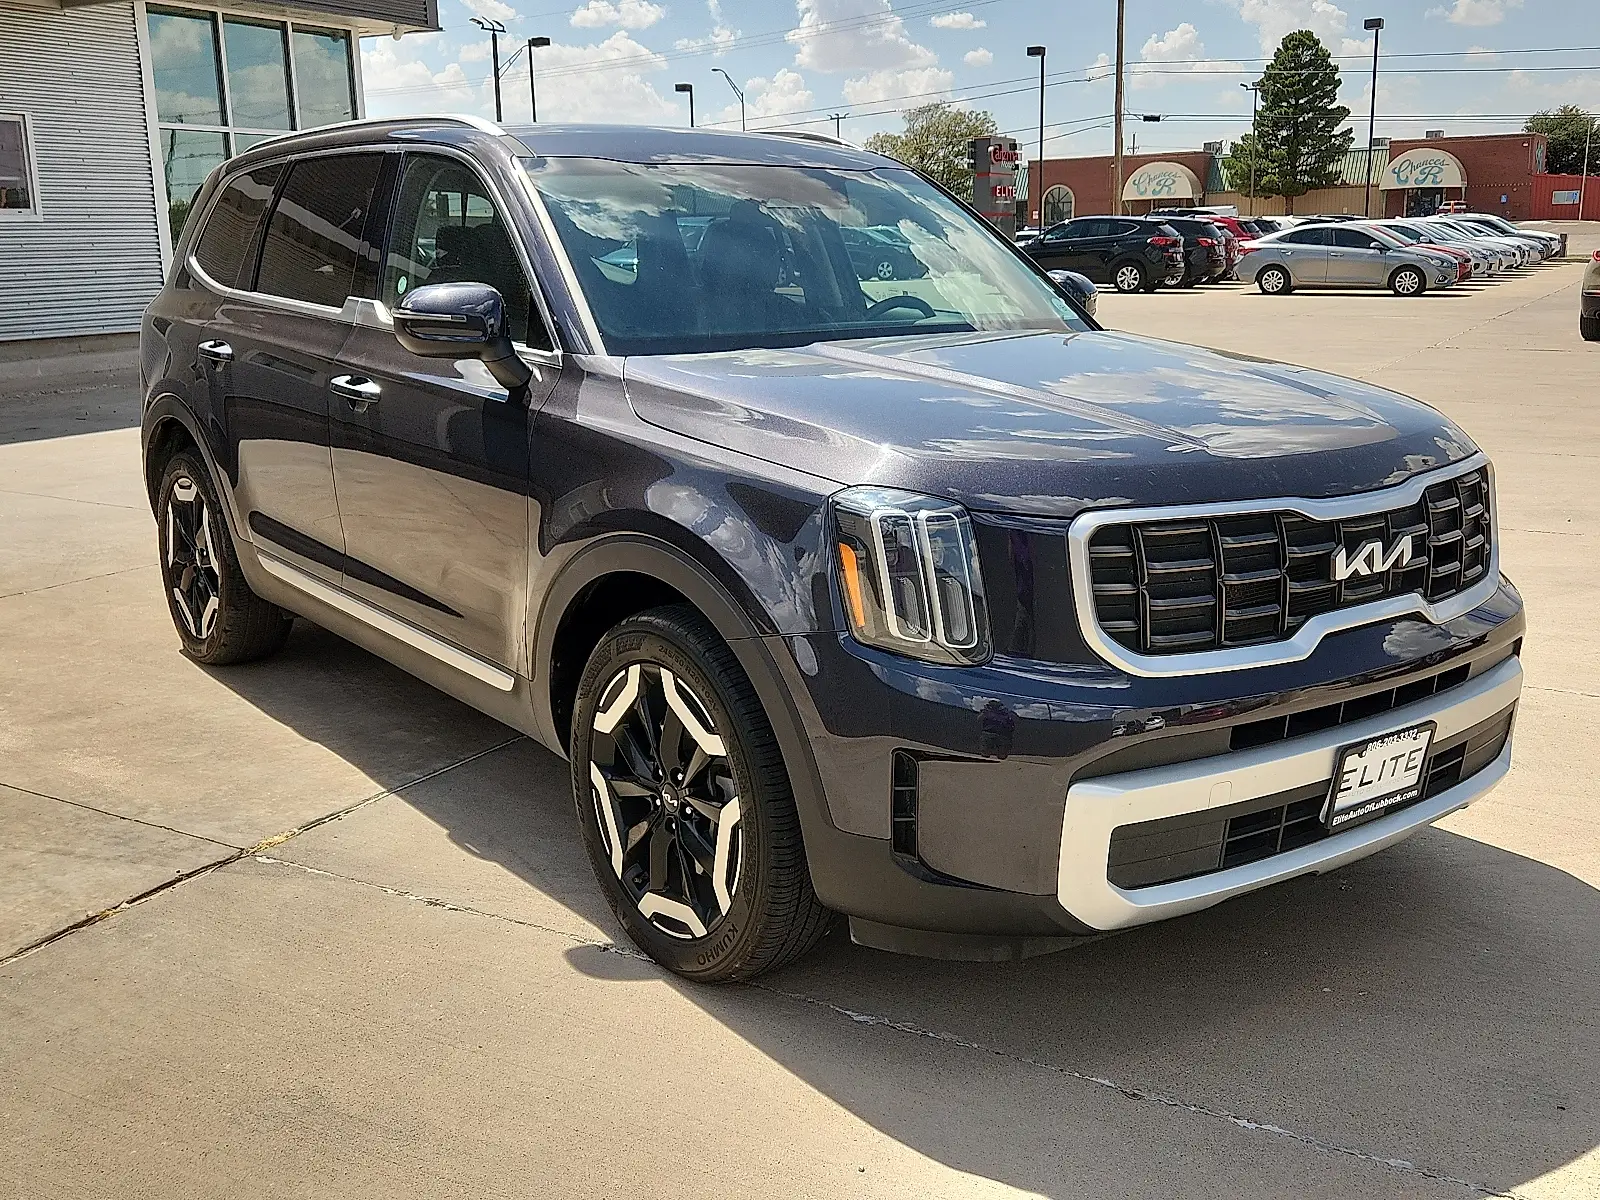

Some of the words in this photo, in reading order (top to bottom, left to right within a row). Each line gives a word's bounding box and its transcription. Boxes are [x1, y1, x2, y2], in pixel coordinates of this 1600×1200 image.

[1132, 171, 1181, 196] Chances
[1391, 159, 1450, 185] Chances
[1414, 165, 1443, 185] R
[996, 185, 1017, 197] ELITE
[1152, 178, 1176, 196] R
[1332, 533, 1412, 581] KIA
[1339, 747, 1423, 793] ELITE
[1332, 790, 1419, 826] EliteAutoOfLubbock.com
[697, 922, 739, 966] KUMHO
